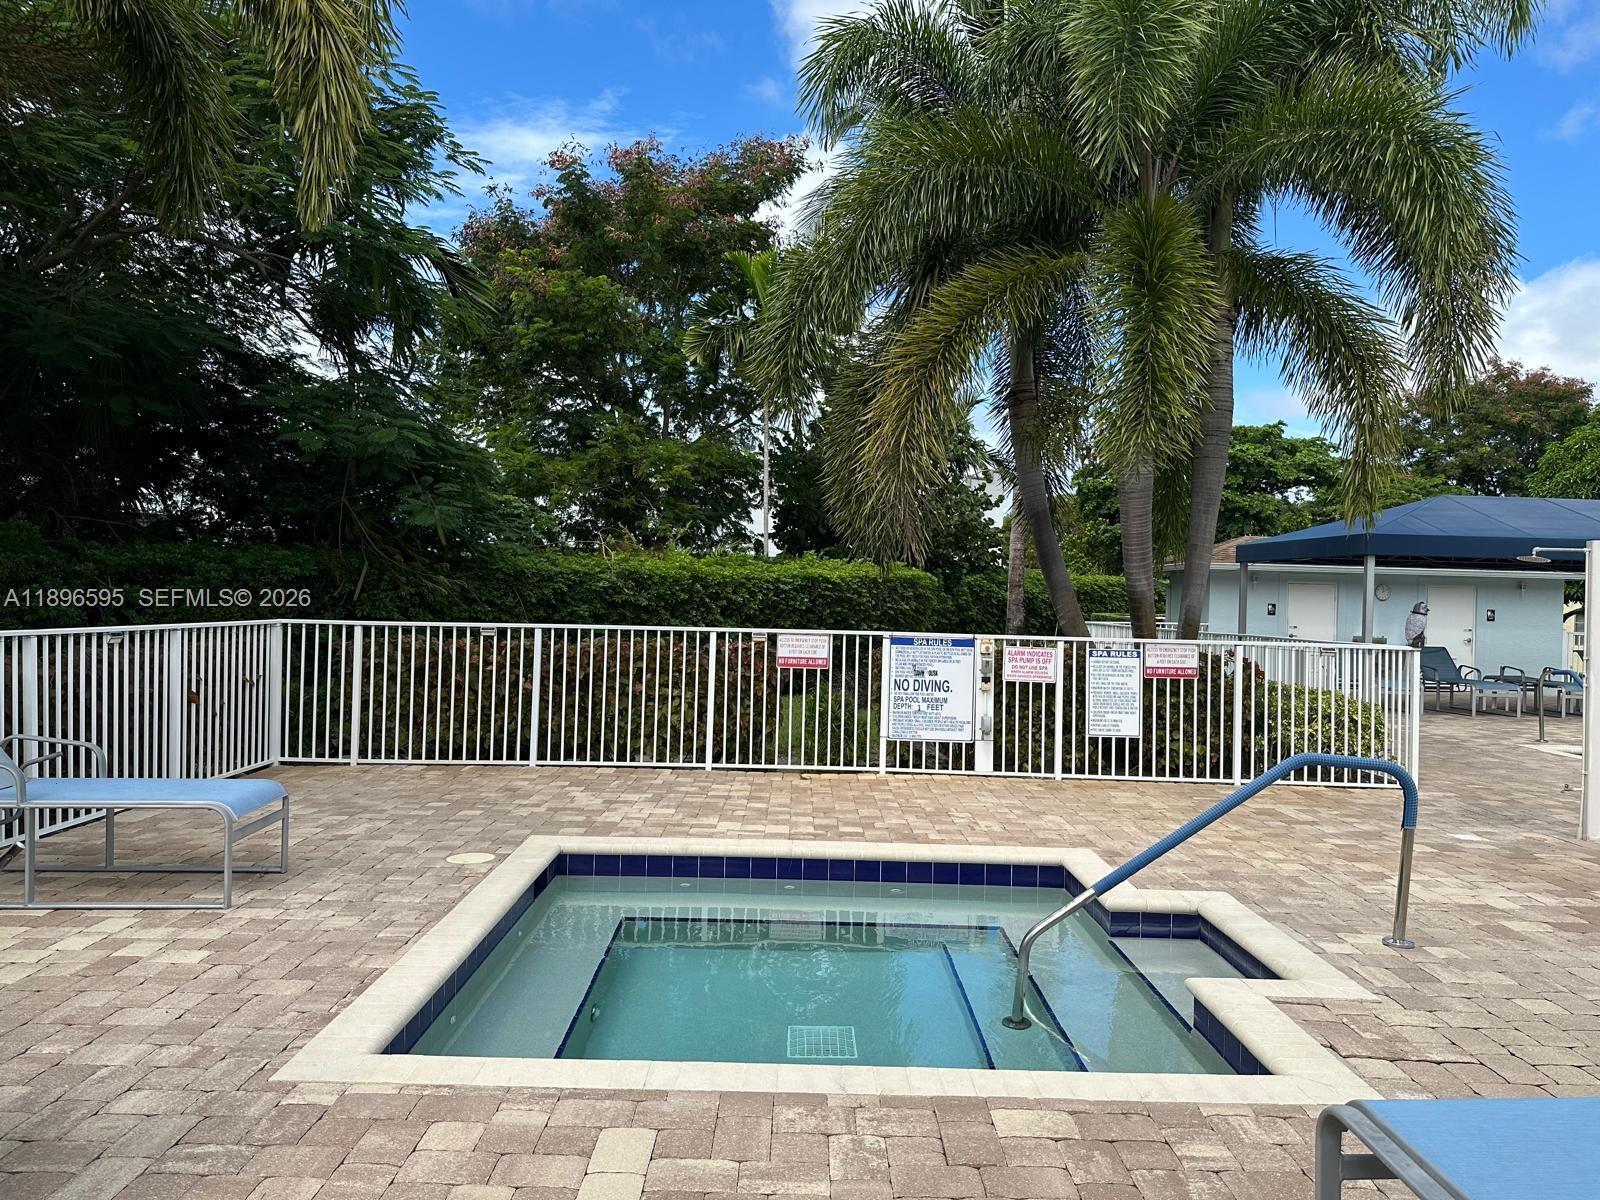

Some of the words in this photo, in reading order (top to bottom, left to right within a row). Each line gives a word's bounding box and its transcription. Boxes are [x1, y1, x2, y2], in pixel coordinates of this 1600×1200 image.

[929, 639, 952, 647] RULES
[893, 679, 910, 692] NO
[913, 679, 953, 693] DIVING.
